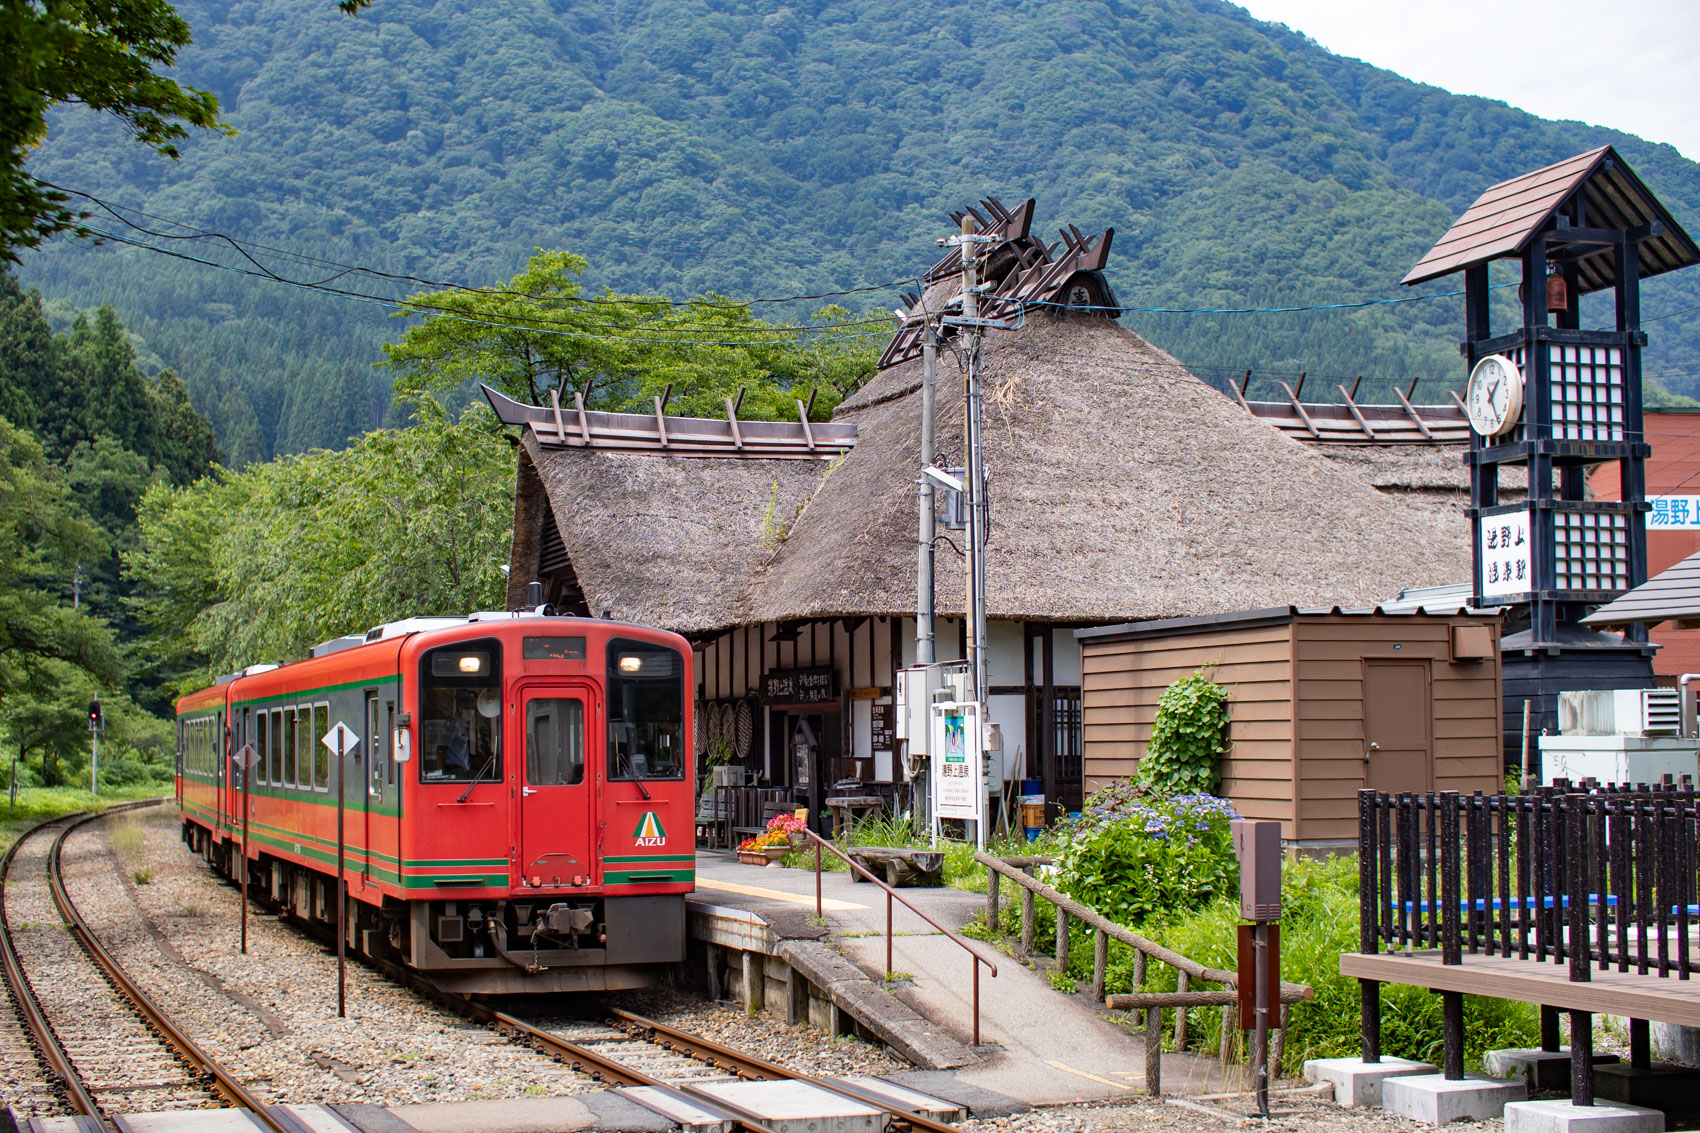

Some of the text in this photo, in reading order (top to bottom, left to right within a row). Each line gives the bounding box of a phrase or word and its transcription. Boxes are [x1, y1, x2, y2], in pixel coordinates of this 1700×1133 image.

[1487, 525, 1525, 550] 湯野上
[1487, 559, 1526, 584] 温泉駅
[635, 837, 666, 847] AIZU
